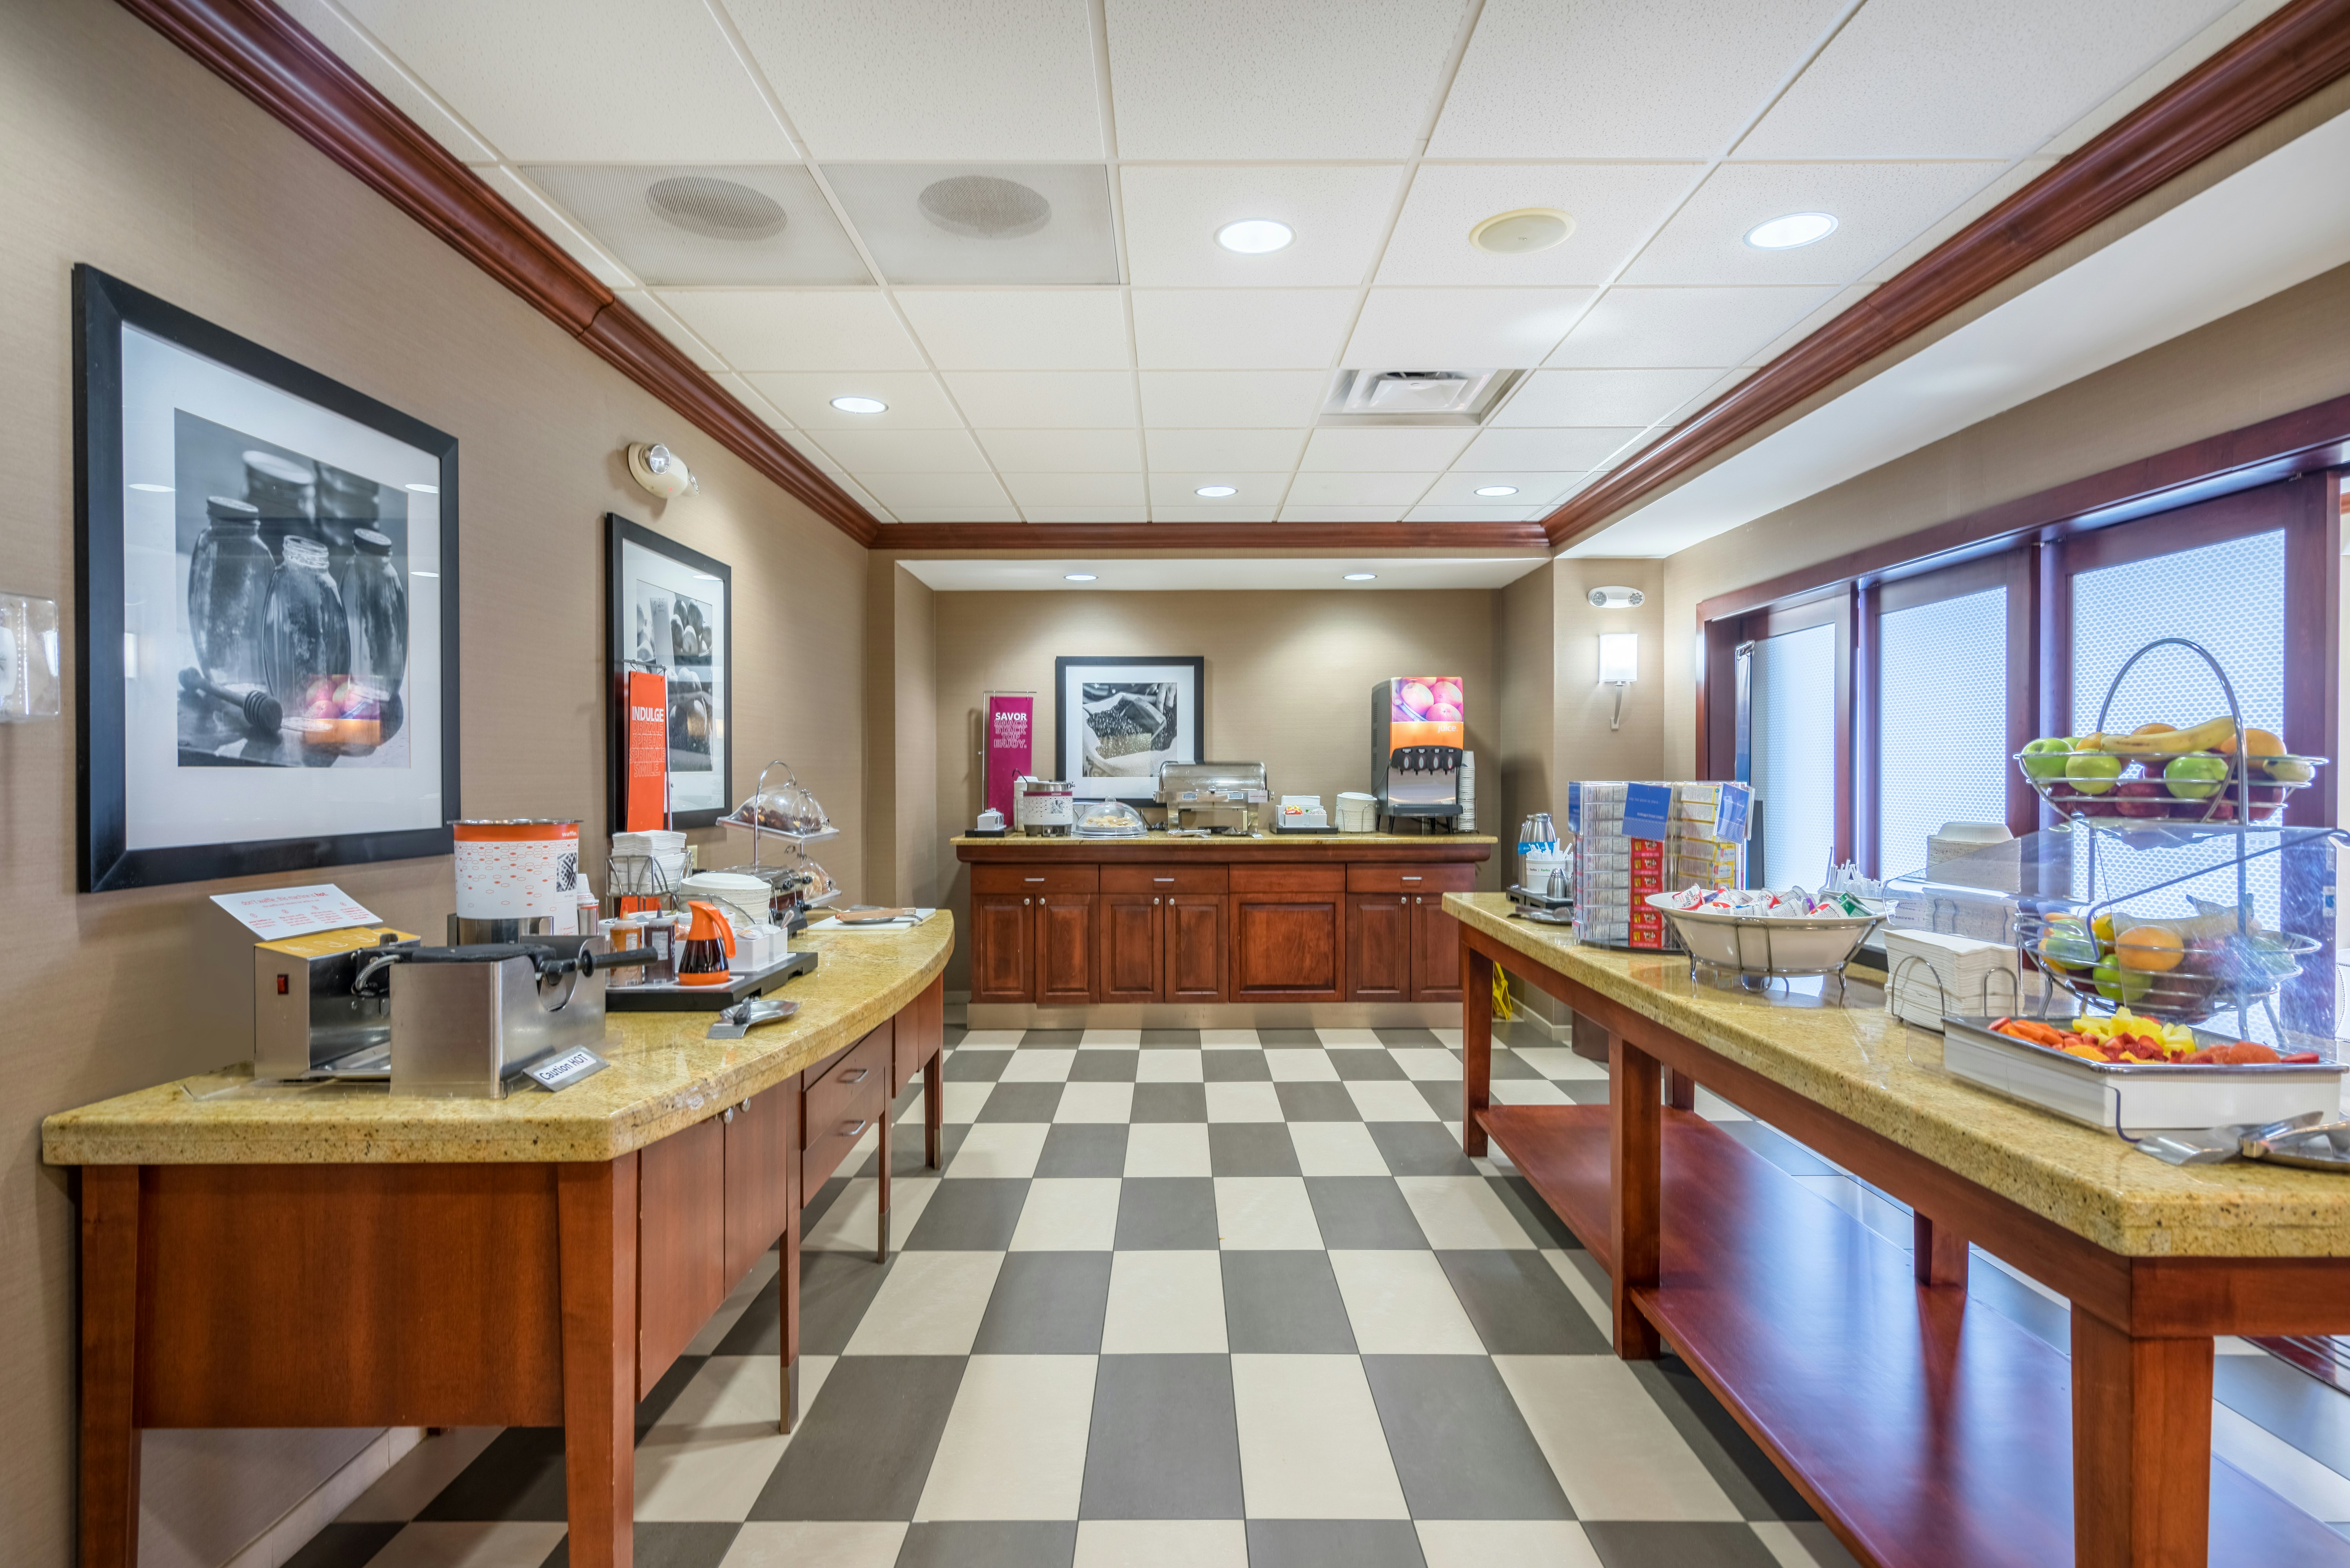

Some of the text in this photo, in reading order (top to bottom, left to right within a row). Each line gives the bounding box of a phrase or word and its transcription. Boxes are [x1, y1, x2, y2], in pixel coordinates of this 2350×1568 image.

[632, 706, 664, 722] INDULGE
[995, 712, 1027, 721] SAVOR
[632, 720, 663, 735] DRIZZLE
[994, 719, 1028, 728] SNACK
[995, 726, 1026, 735] STACK
[632, 734, 663, 749] SPREAD
[994, 739, 1027, 748] ENJOY.
[1001, 732, 1020, 742] TOP
[629, 748, 665, 763] SPRINKLE
[634, 762, 661, 777] SMILE.
[539, 1054, 588, 1080] Caution HOT
